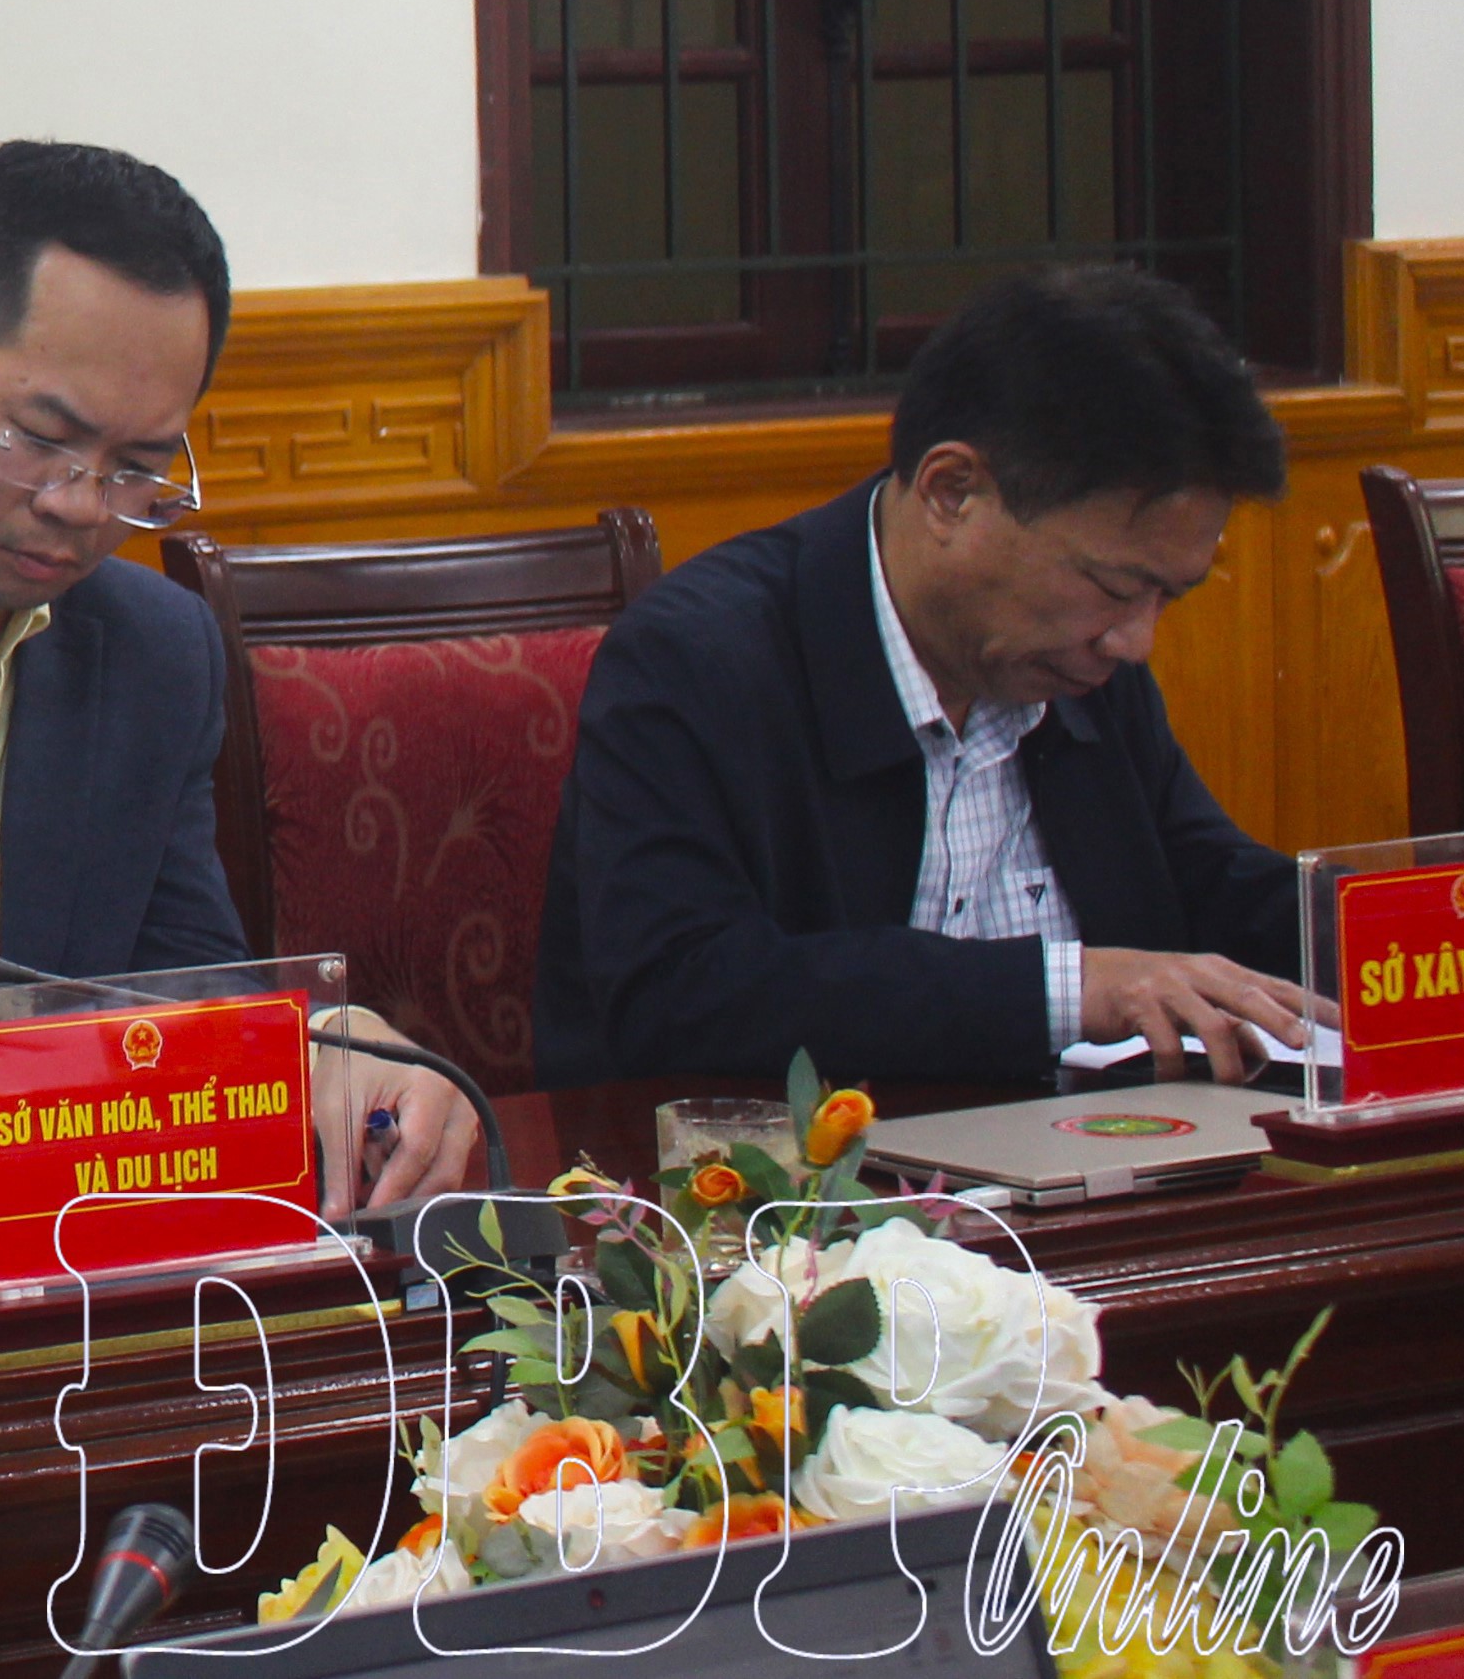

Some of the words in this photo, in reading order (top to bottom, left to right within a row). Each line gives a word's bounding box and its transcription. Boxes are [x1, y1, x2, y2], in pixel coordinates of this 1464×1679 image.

[1360, 941, 1406, 1007] SỞ
[1412, 941, 1464, 1000] XÂ
[38, 1098, 94, 1141] VĂN
[100, 1092, 162, 1134] HÓA,
[169, 1075, 218, 1126] THỂ
[223, 1080, 289, 1118] THAO
[74, 1153, 110, 1195] VÀ
[116, 1156, 152, 1190] DU
[159, 1147, 218, 1191] LỊCH
